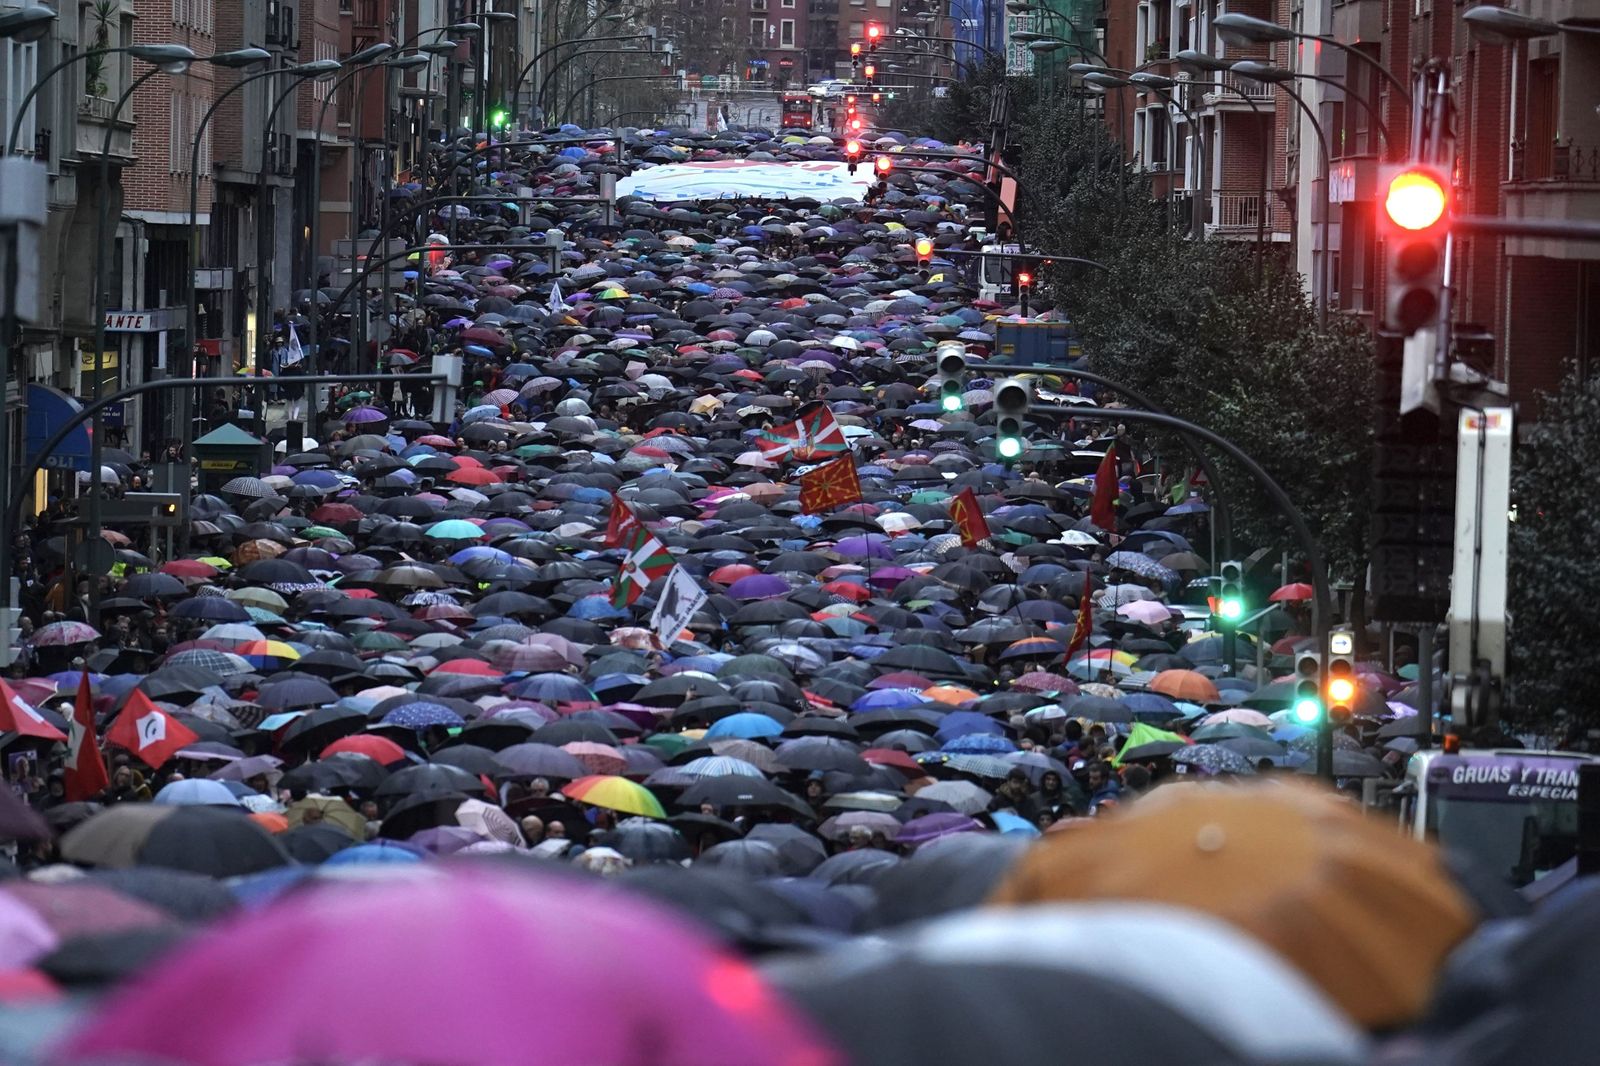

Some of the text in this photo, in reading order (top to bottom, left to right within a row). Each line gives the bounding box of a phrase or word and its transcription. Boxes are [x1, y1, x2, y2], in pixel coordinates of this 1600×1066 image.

[1452, 765, 1579, 787] GRUAS Y TRAN
[1508, 784, 1578, 800] ESPECIA
